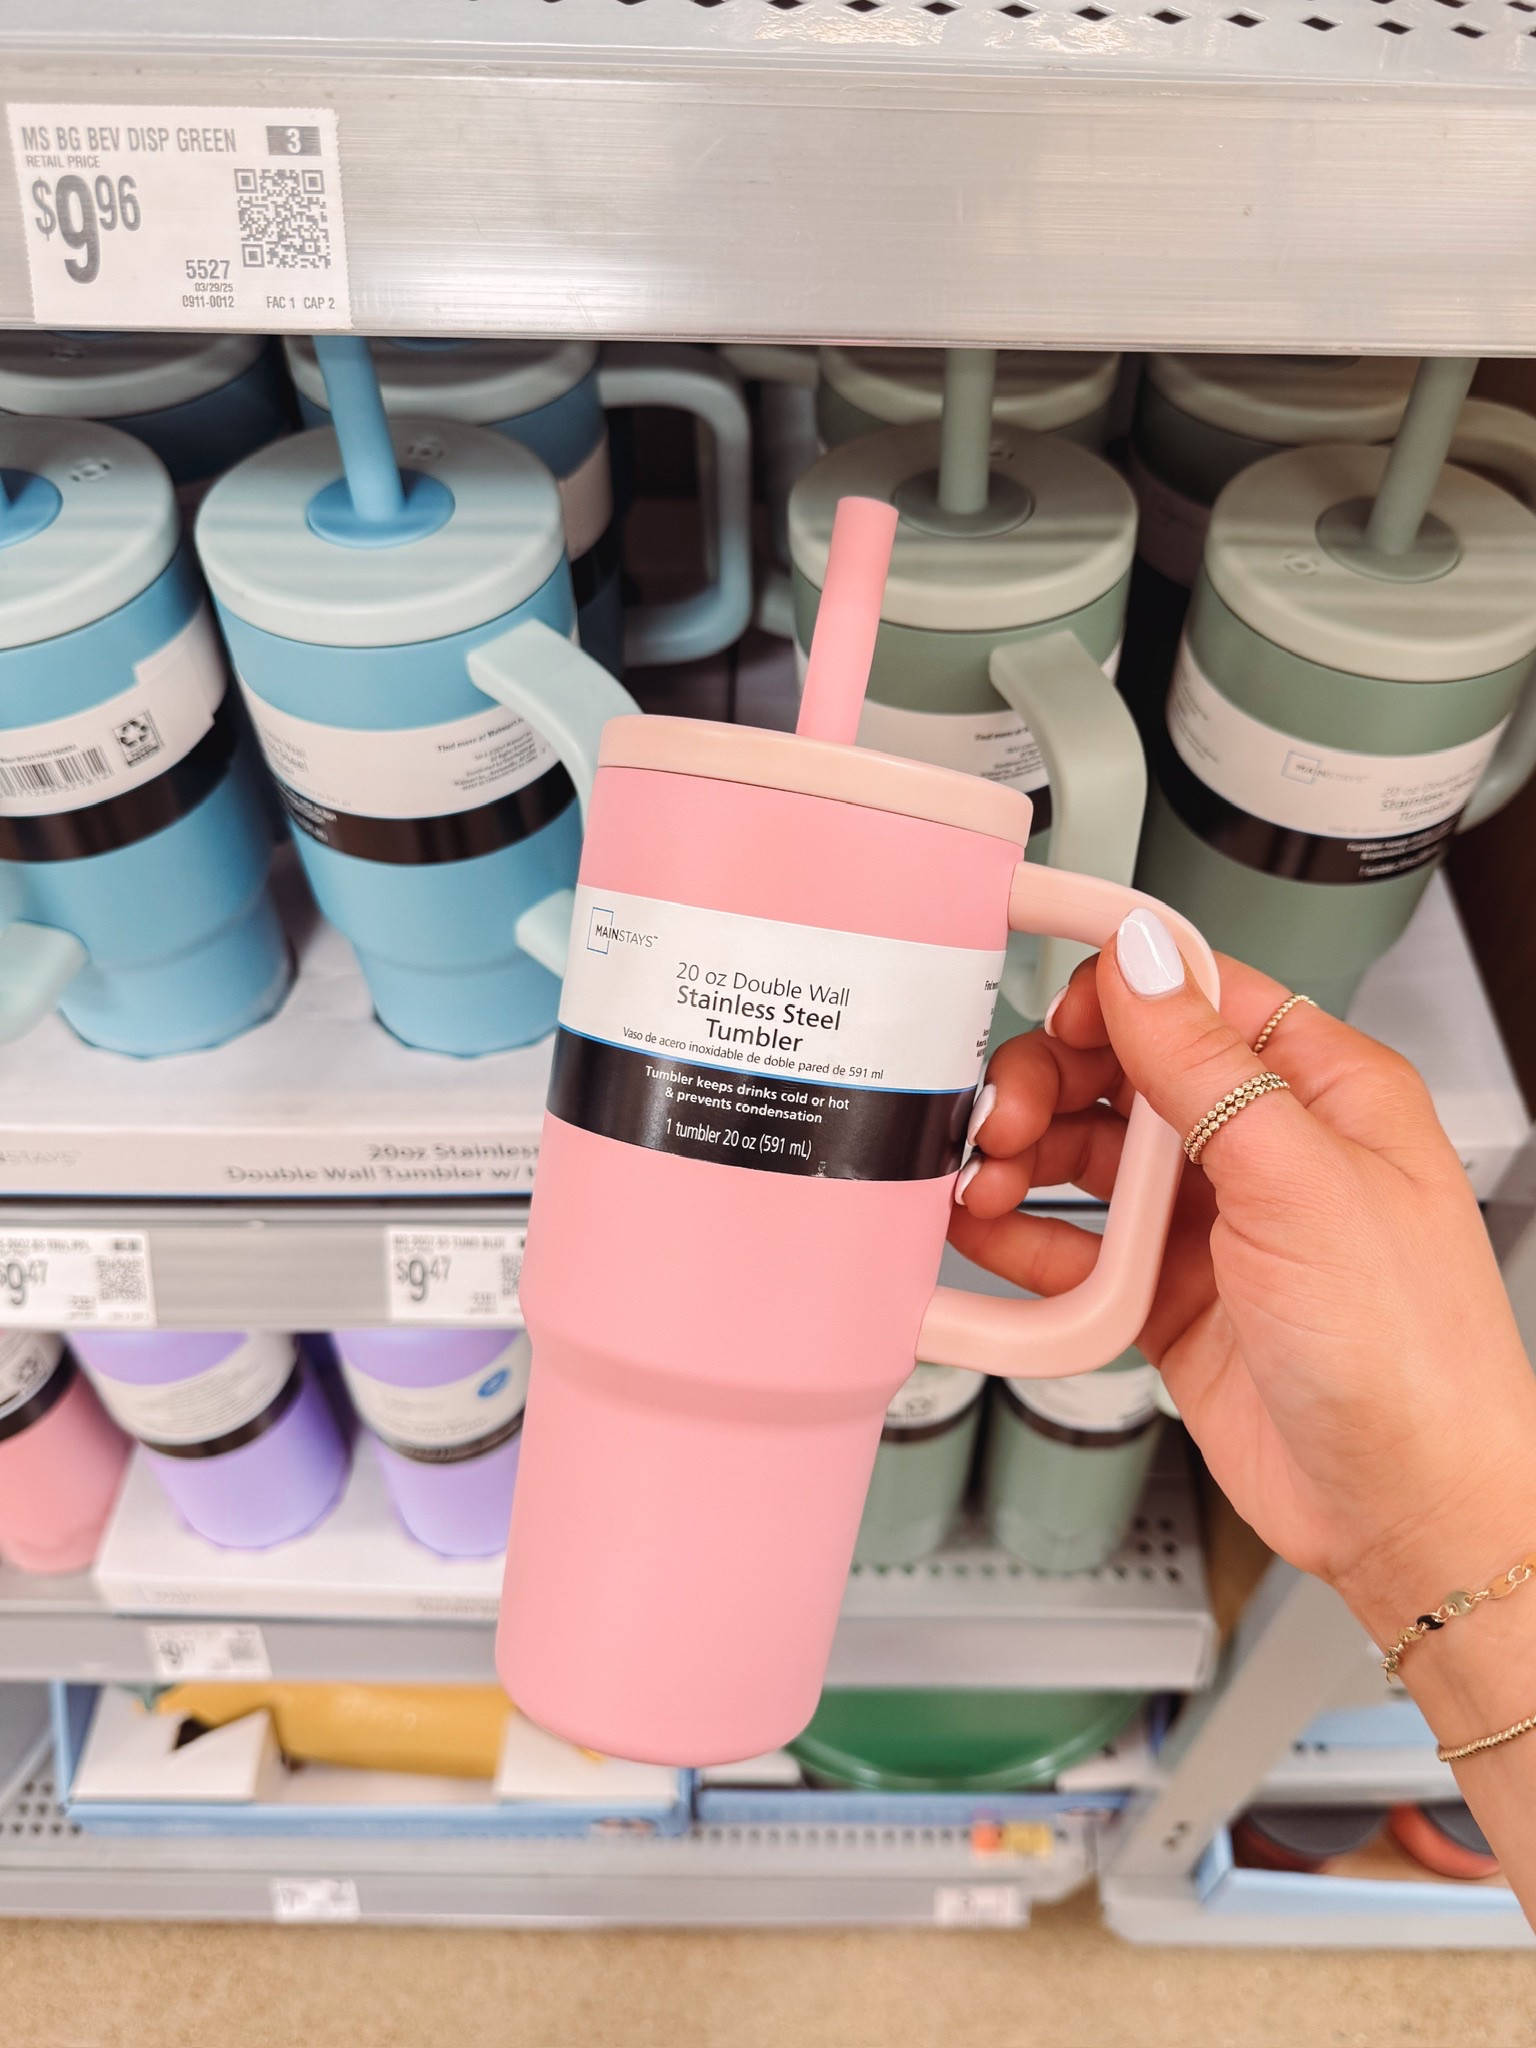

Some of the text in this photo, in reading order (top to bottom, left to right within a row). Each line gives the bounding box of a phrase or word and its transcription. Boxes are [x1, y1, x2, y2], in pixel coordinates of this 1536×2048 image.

[21, 126, 238, 153] MS BG BEV DISP GREEN
[286, 128, 302, 154] 3
[26, 155, 101, 169] RETAIL PRICE
[185, 260, 231, 280] 5527
[195, 282, 234, 293] 03/29/25
[266, 296, 336, 310] FAC 1 CAP 2
[676, 961, 850, 1007] 20 oz Double Wall
[677, 985, 842, 1031] Stainless Steel
[706, 1018, 804, 1052] Tumbler
[623, 1026, 884, 1080] Vaso de acero inoxidable de doble pared de 591 ml
[645, 1065, 851, 1110] Tumbler keeps drinks cold or hot
[665, 1086, 823, 1124] & prevents condensation
[666, 1118, 812, 1161] 1 tumbler 20 oz (591 mL)
[225, 1164, 318, 1184] Double
[322, 1164, 376, 1182] Wall
